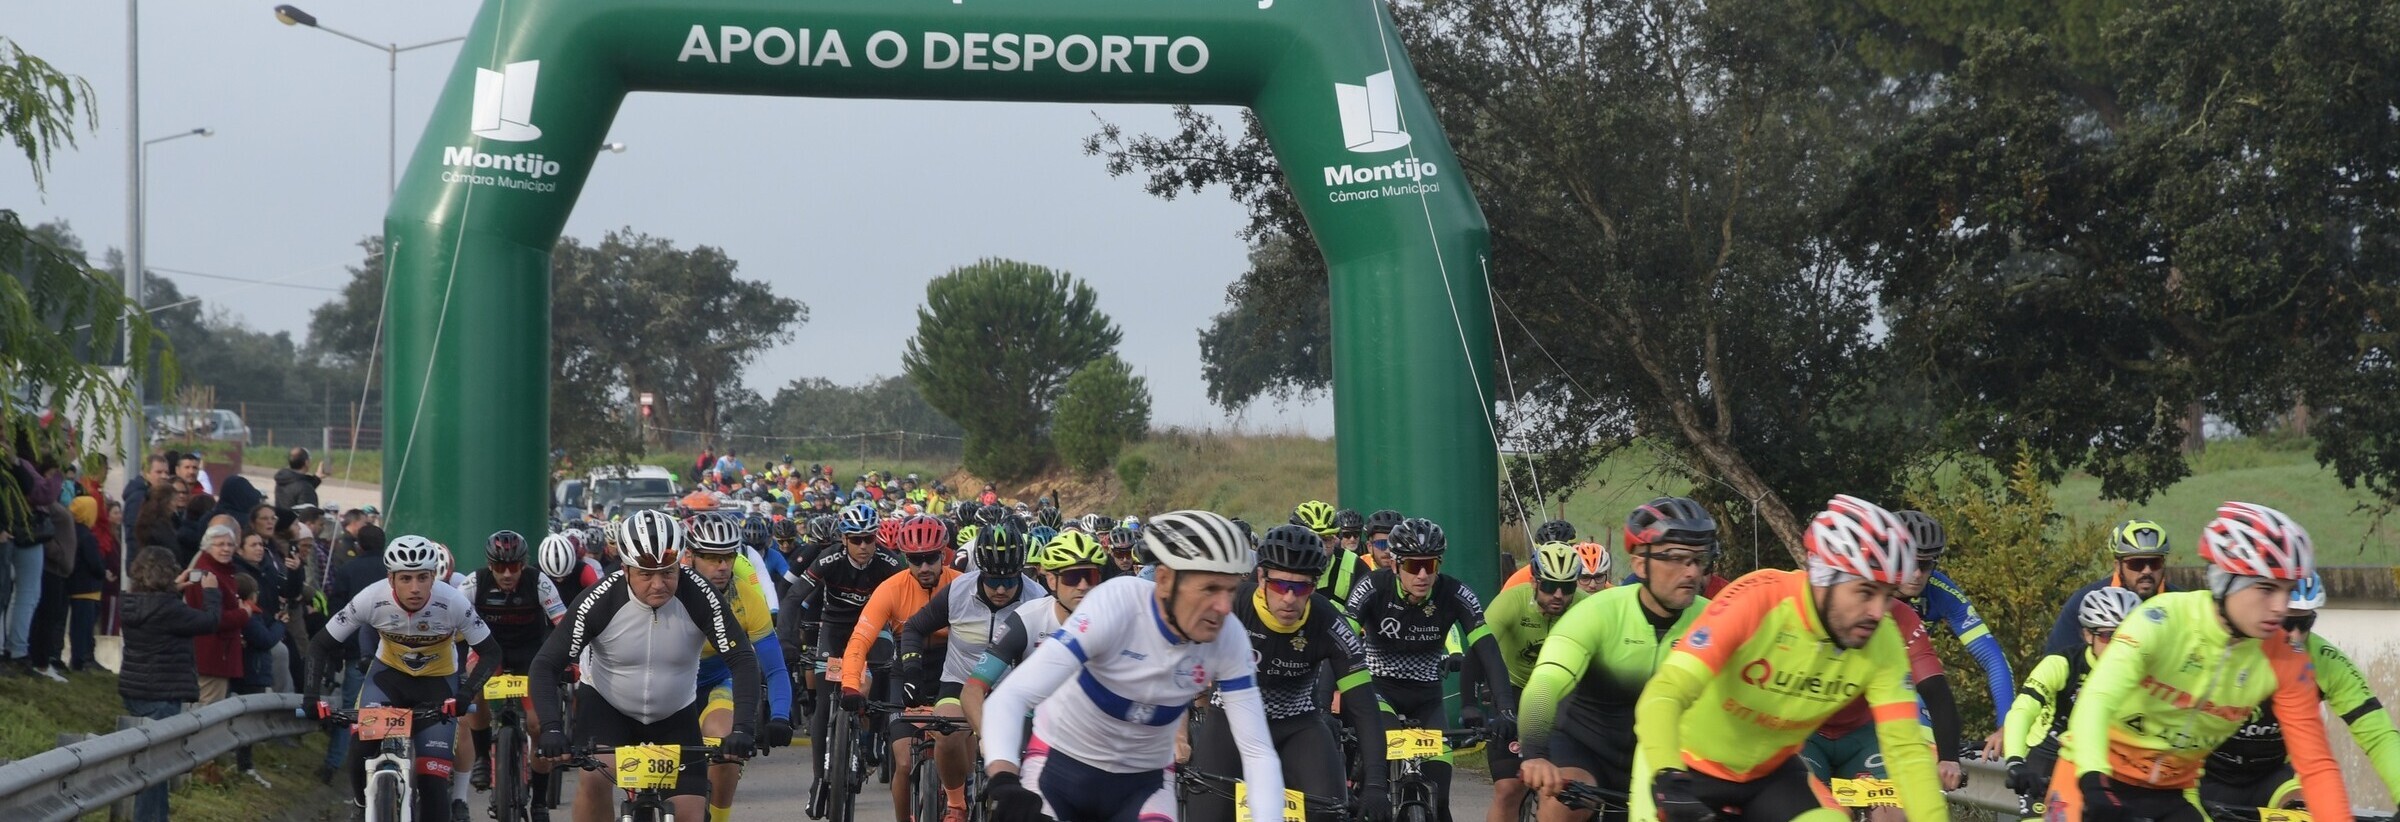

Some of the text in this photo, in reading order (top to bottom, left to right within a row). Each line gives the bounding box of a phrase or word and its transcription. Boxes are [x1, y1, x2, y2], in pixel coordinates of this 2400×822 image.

[678, 25, 1209, 74] APOIA O DESPORTO
[443, 146, 560, 178] Montijo
[441, 170, 556, 192] Câmara Municipal
[1324, 158, 1437, 186] Montijo
[1329, 182, 1440, 203] Câmara Municipal
[840, 591, 870, 602] FOCU
[1347, 578, 1375, 609] TWENTY
[1457, 584, 1483, 615] TWENTY
[1331, 617, 1363, 656] TWENTY
[1408, 625, 1440, 634] Quinta
[1271, 657, 1310, 669] Quinta
[507, 680, 523, 689] 517
[385, 716, 406, 728] 136
[1415, 738, 1435, 747] 417
[647, 758, 675, 774] 388
[1867, 786, 1895, 798] 616
